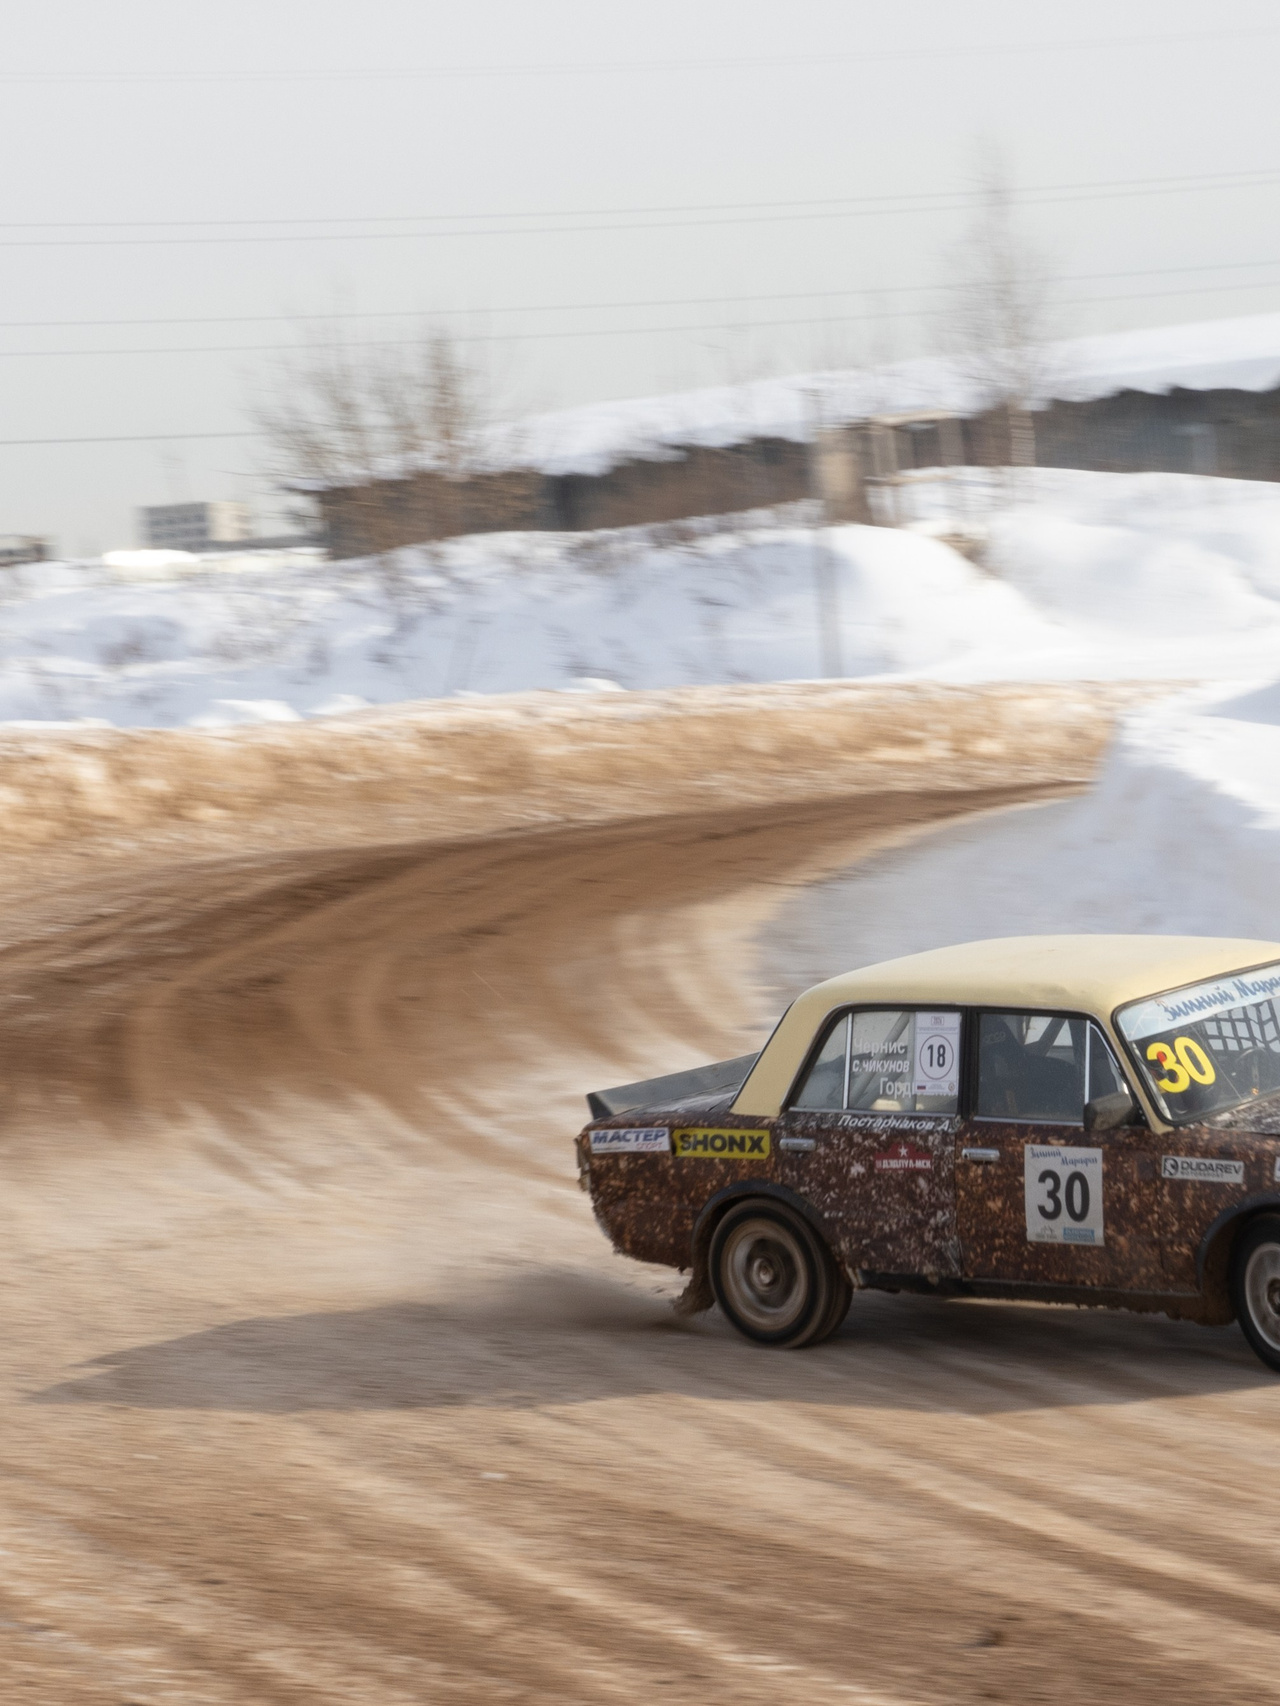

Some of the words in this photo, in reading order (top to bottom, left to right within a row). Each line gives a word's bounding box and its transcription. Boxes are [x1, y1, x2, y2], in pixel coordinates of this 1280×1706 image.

[927, 1044, 947, 1068] 18
[1146, 1036, 1216, 1093] 30
[592, 1129, 667, 1144] МАСТЕР
[679, 1133, 766, 1154] SHONX
[1180, 1160, 1242, 1175] DUDAREV
[1037, 1168, 1091, 1223] 30
